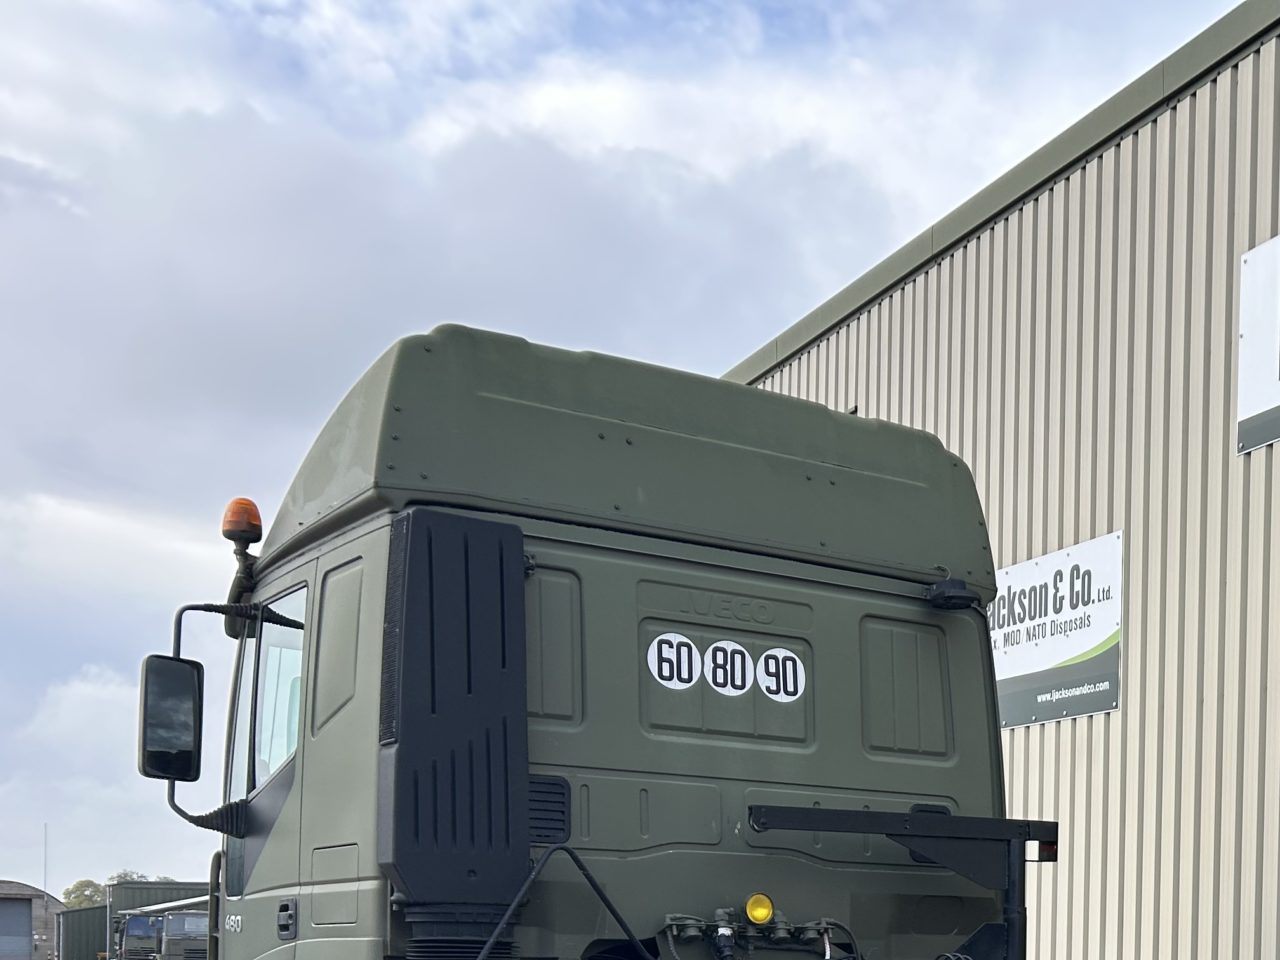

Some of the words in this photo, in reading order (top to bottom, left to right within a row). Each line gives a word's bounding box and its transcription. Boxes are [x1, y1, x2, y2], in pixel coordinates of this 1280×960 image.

[1053, 569, 1065, 614] &
[1069, 563, 1095, 611] Co.
[1098, 585, 1113, 603] Ltd.
[1003, 622, 1047, 648] MOD/NATO
[1050, 611, 1091, 637] Disposals
[657, 639, 693, 684] 60
[712, 646, 746, 691] 80
[763, 654, 798, 697] 90
